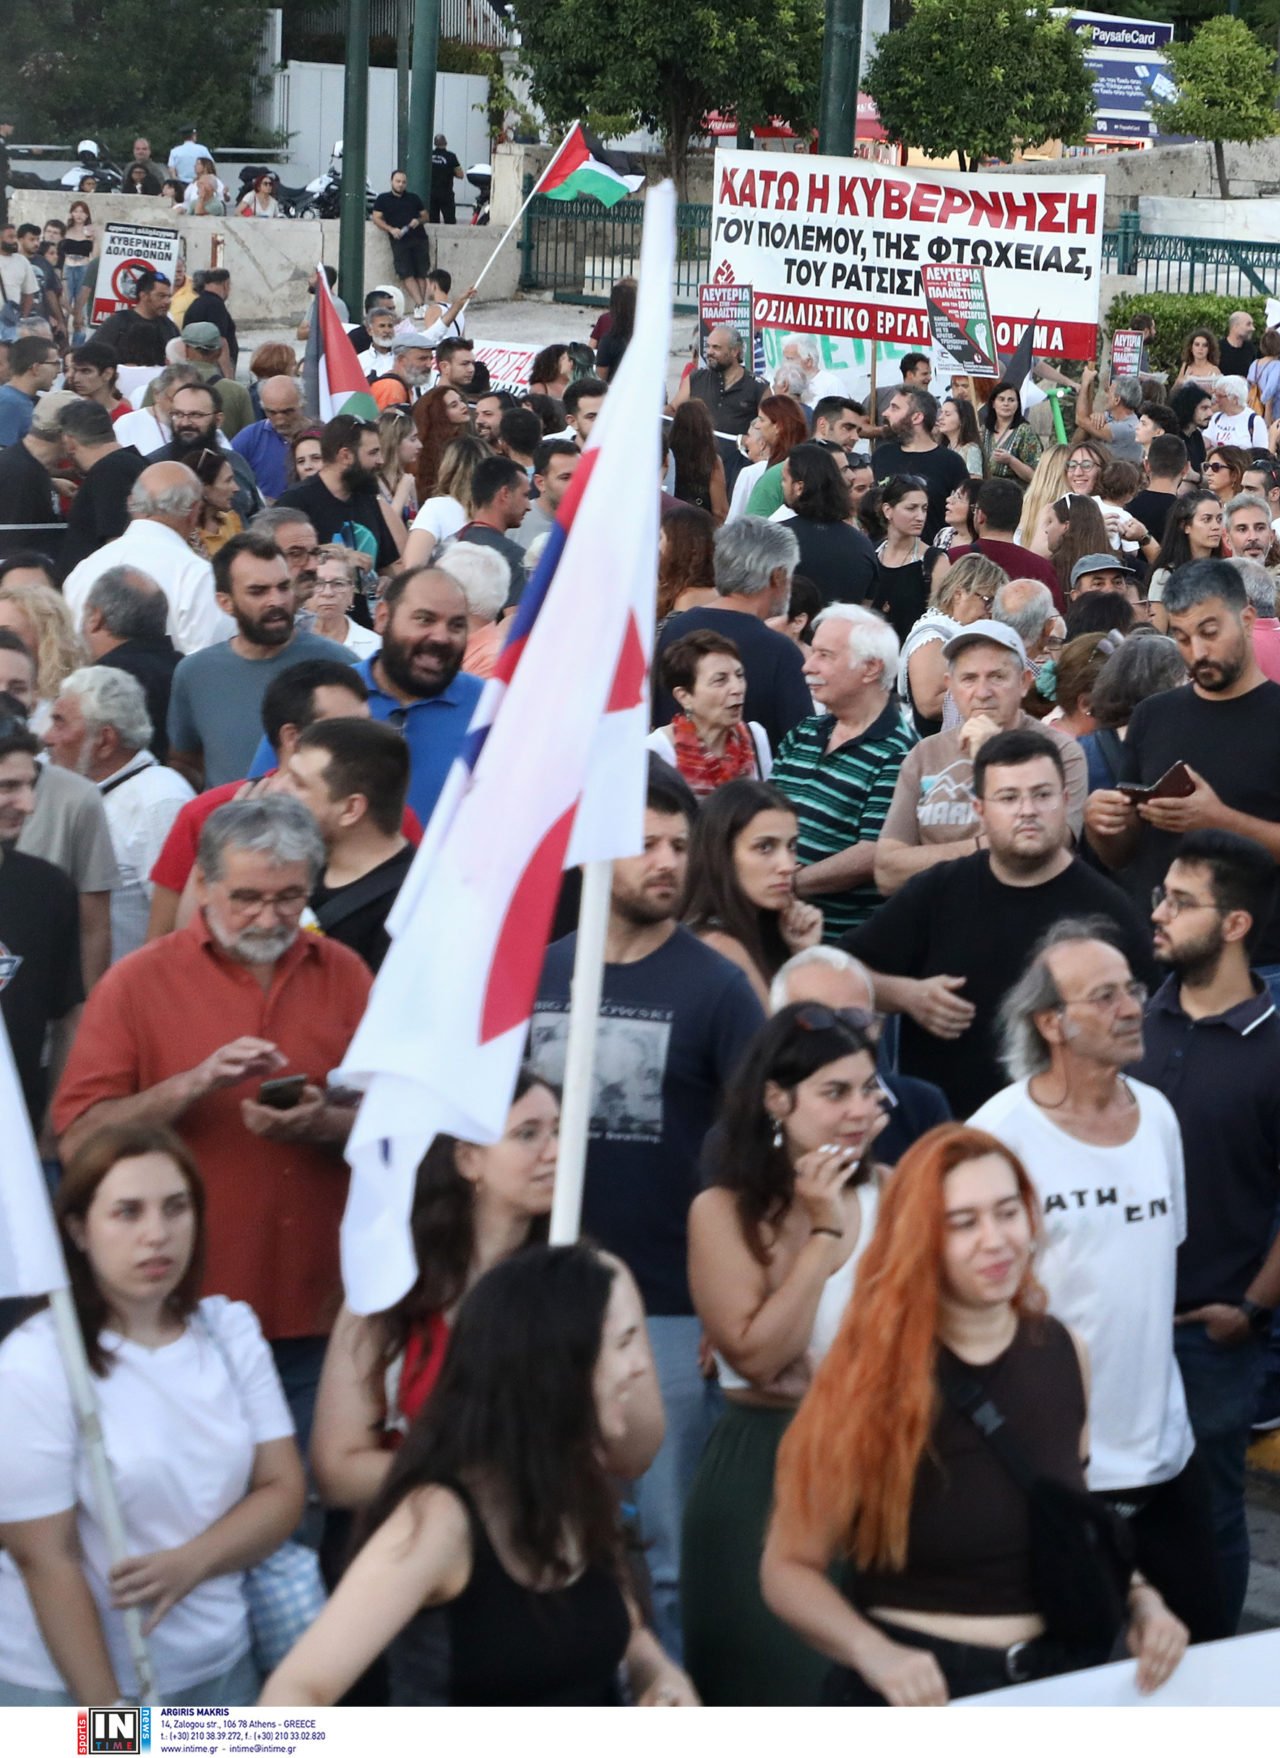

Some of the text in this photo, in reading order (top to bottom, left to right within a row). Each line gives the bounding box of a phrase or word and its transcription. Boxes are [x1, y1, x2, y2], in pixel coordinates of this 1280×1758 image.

[1092, 26, 1155, 45] PaysafeCard
[719, 166, 1098, 235] ΚΑΤΩ Η ΚΥΒΕΡΝΗΣΗ
[109, 235, 171, 251] ΚΥΒΕΡΝΗΣΗ
[758, 221, 867, 262] ΠΟΛΕΜΟΥ,
[872, 230, 921, 261] ΤΗΣ
[927, 235, 1093, 281] ΦΤΩΧΕΙΑΣ,
[105, 246, 172, 261] ΔΟΛΟΦΟΝΩΝ
[784, 257, 925, 297] ΤΟΥ ΡΑΤΣΙΣ
[926, 267, 981, 282] ΛΕΥΤΕΡΙΑ
[702, 288, 749, 301] ΛΕΥΤΕΡΙΑ
[928, 286, 984, 301] ΠΑΛΑΙΣΤΙΝΗ
[702, 307, 749, 319] ΠΑΛΑΙΣΤΙΝΗ
[753, 297, 1064, 351] ΟΣΙΑΛΙΣΤΙΚΟ ΕΡΓΑΤ ΟΜΜΑ
